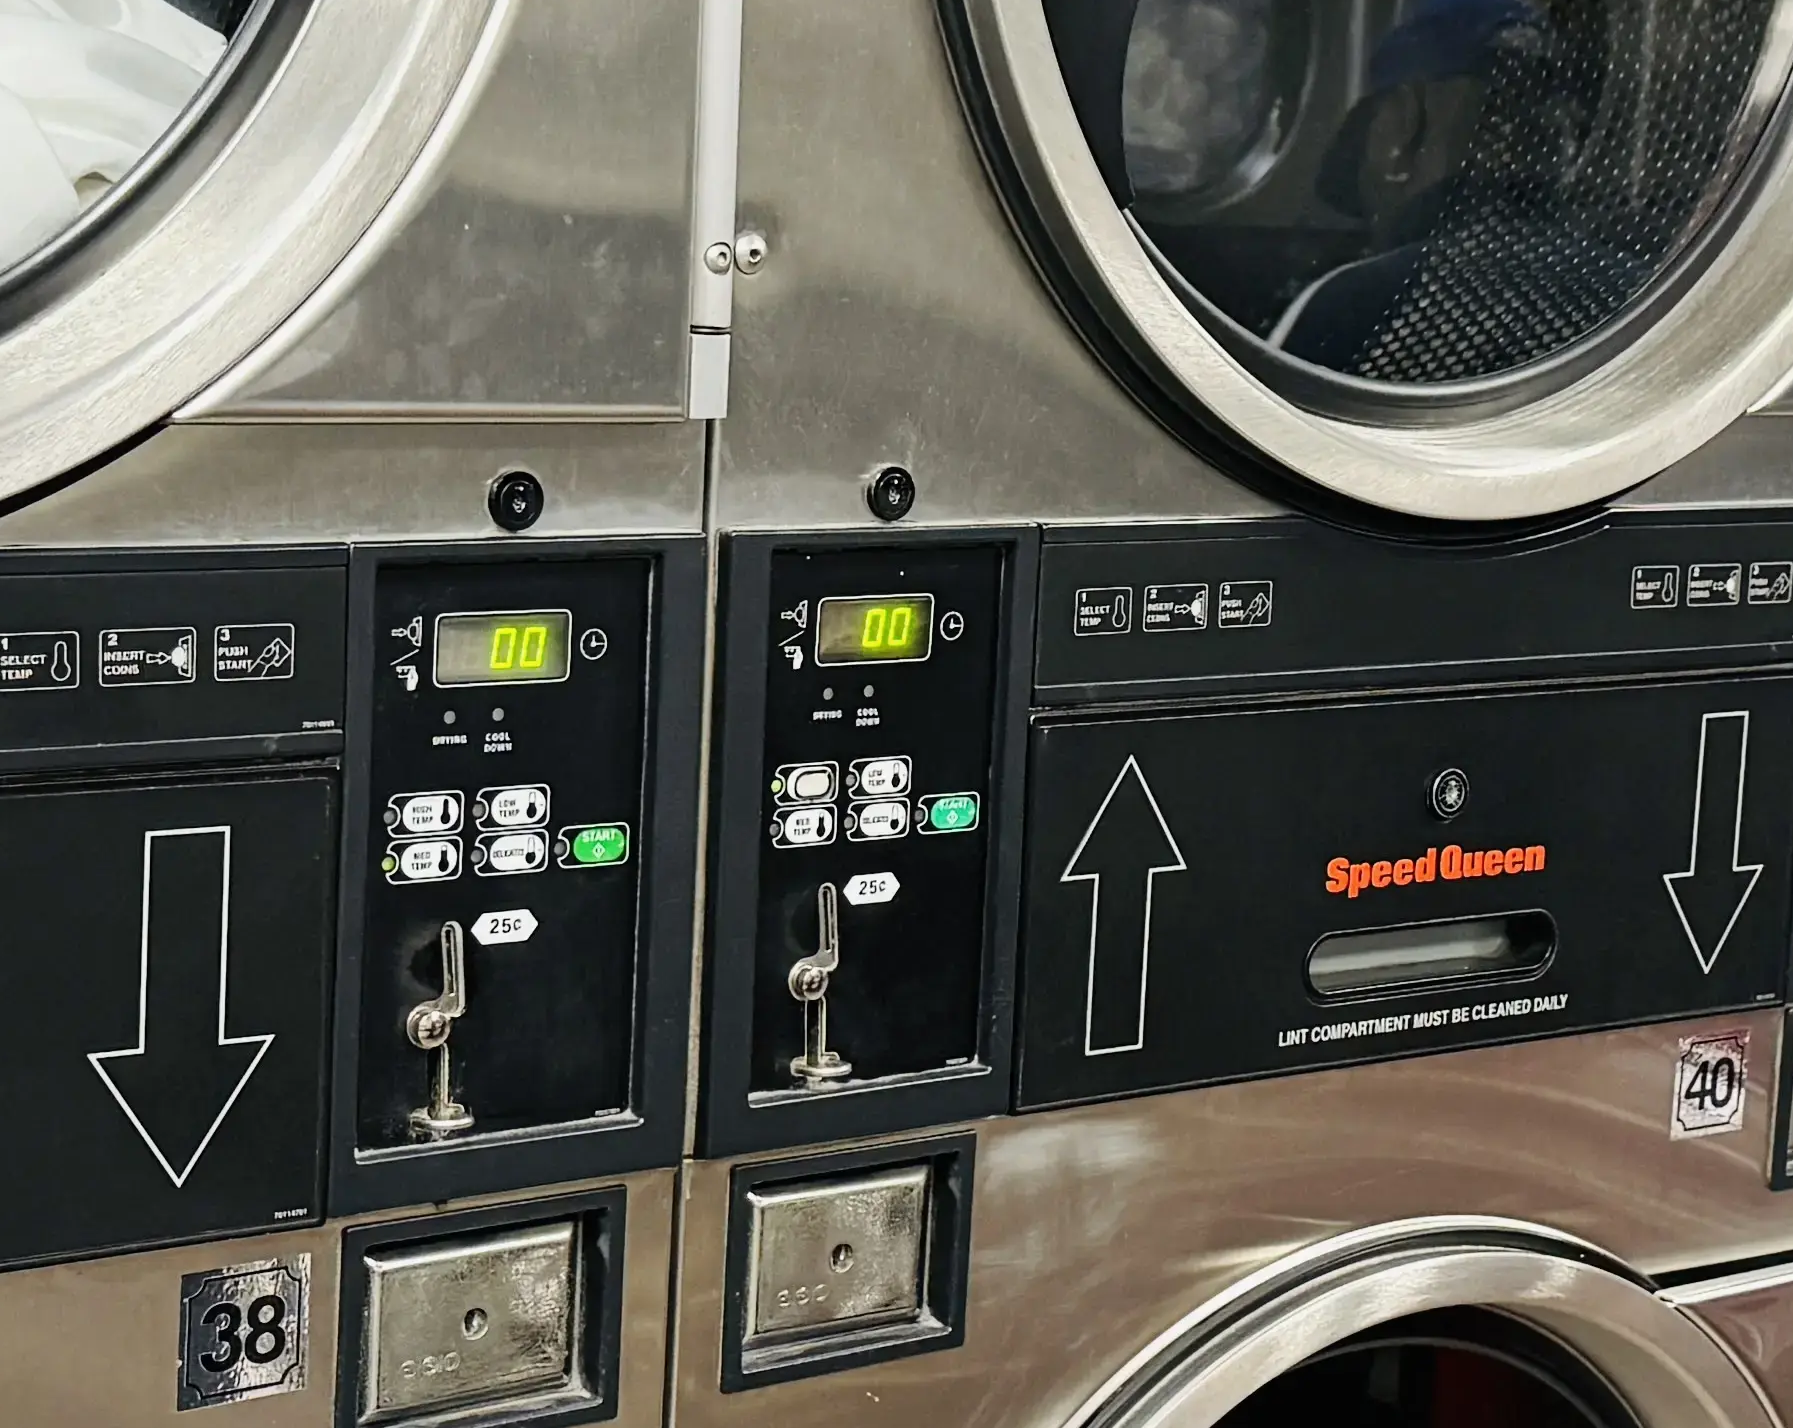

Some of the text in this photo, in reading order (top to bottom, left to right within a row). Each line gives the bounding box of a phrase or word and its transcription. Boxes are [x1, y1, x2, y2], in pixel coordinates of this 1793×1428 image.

[1080, 605, 1110, 615] SELECT
[862, 607, 911, 648] 00
[108, 634, 118, 646] 2
[220, 629, 231, 642] 3
[1, 638, 9, 650] 1
[490, 626, 547, 669] 00
[104, 650, 145, 662] INSERT
[218, 647, 249, 657] PUSH
[0, 653, 47, 666] SELECT
[218, 659, 253, 671] START
[1, 669, 33, 681] TEMP
[104, 664, 140, 676] COINS
[485, 732, 510, 742] COOL
[499, 799, 516, 809] LOW
[582, 830, 616, 842] START
[1325, 845, 1545, 898] Speed Queen
[1278, 993, 1569, 1047] LINT COMPARTMENT MUST BE CLEANED DAILY
[1684, 1057, 1735, 1110] 40
[199, 1293, 287, 1374] 38
